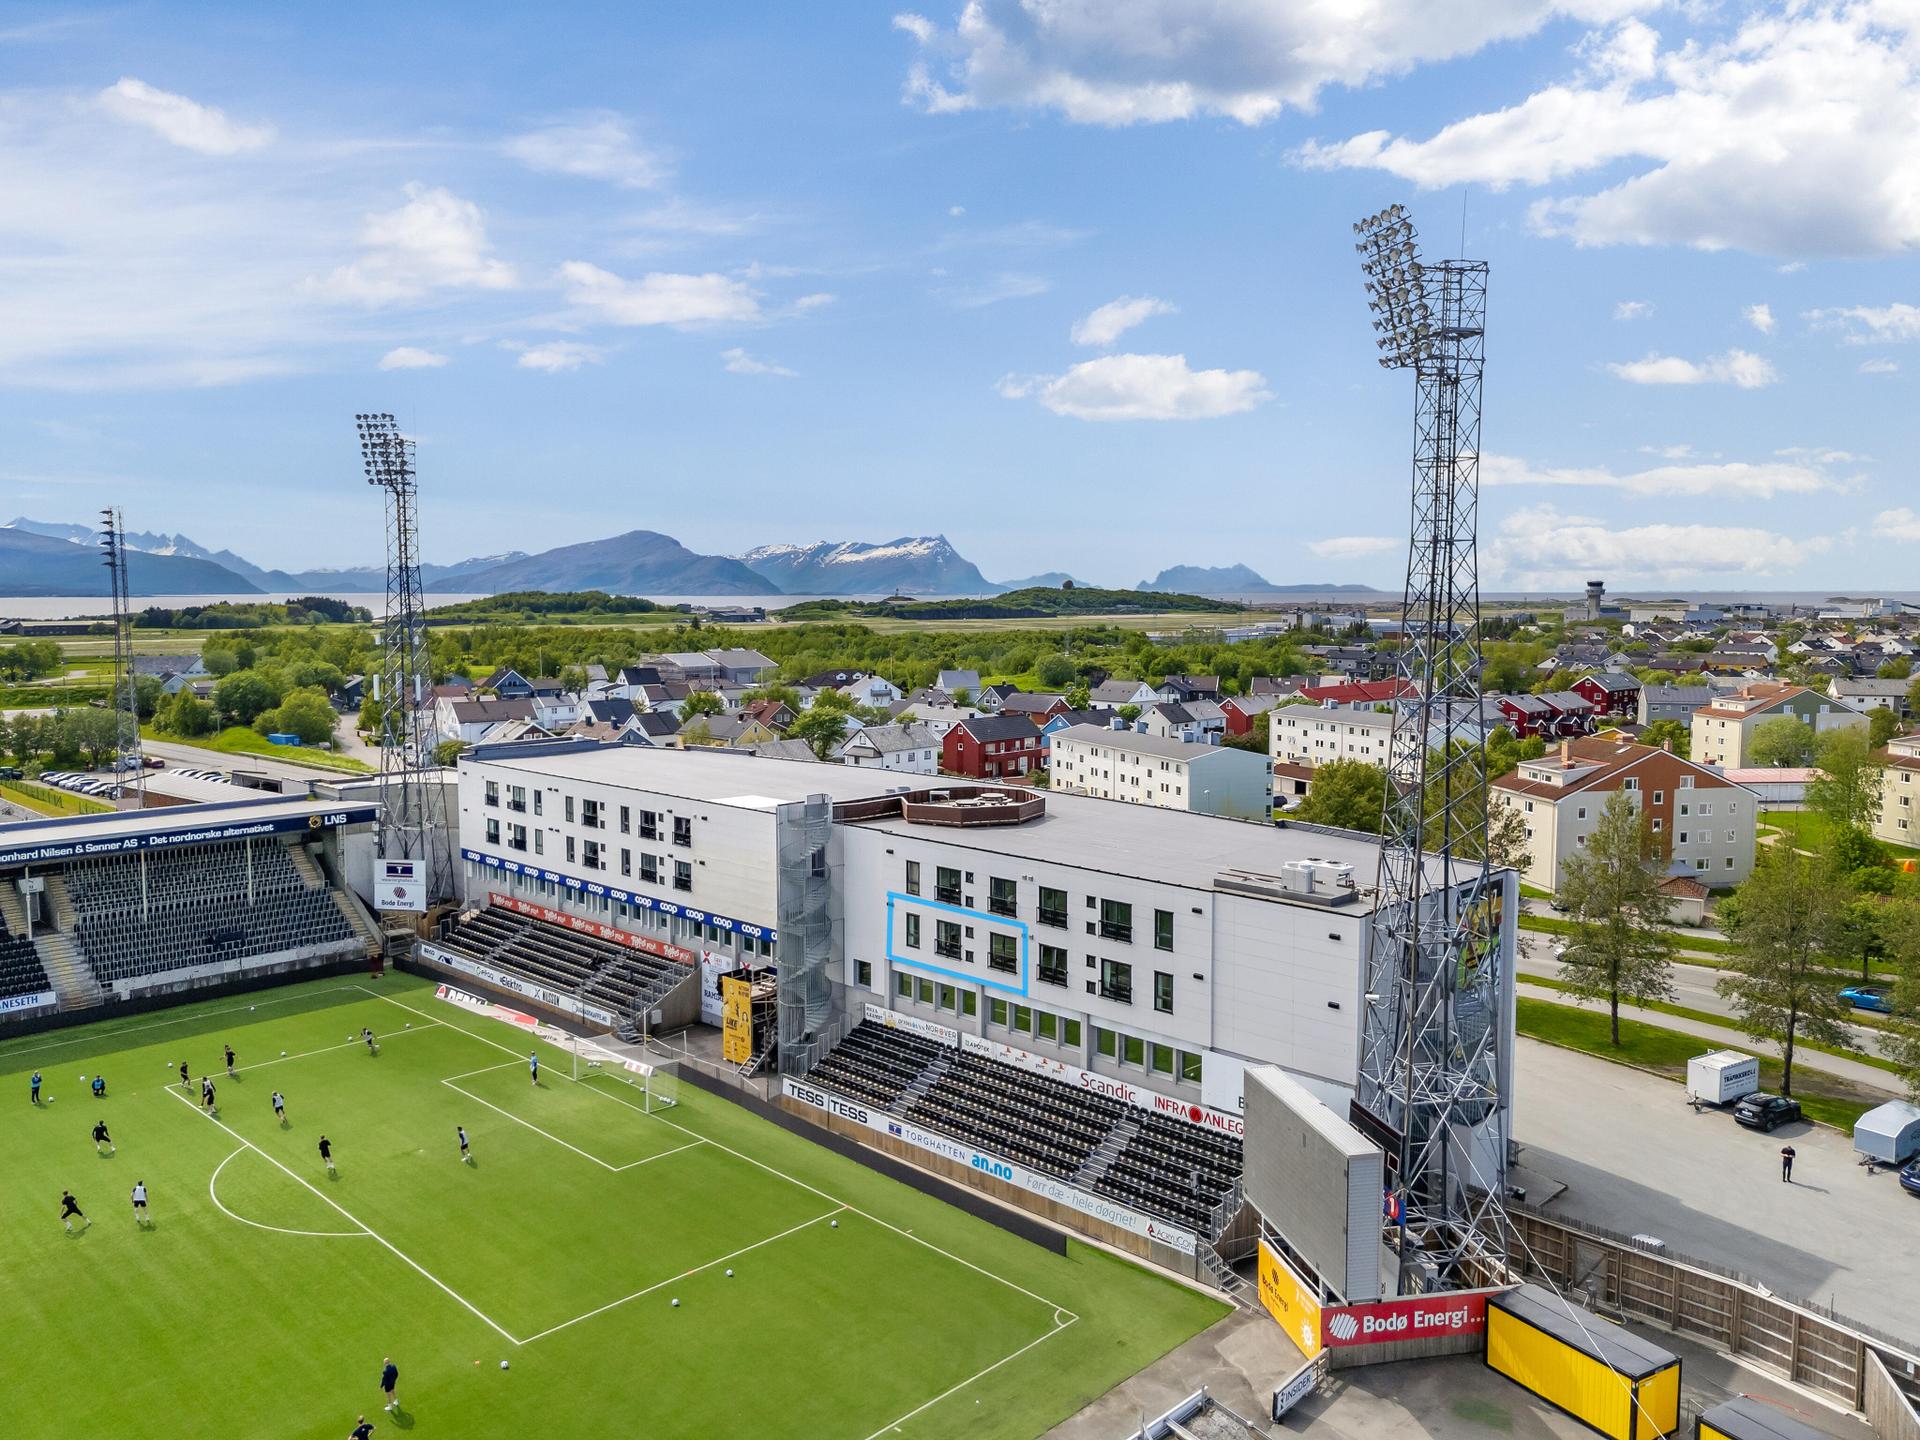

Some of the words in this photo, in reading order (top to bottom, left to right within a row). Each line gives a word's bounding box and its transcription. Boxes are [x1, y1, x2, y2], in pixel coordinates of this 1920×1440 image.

[324, 814, 347, 825] LNS
[0, 850, 38, 862] onhard
[40, 847, 72, 857] Nilsen
[75, 845, 84, 853] &
[86, 841, 121, 852] Sønner
[123, 839, 138, 848] AS
[150, 836, 168, 845] Det
[169, 830, 222, 843] nordnorske
[223, 824, 274, 837] alternativet
[468, 852, 480, 861] coop
[486, 856, 499, 867] coop
[505, 861, 518, 872] coop
[524, 866, 538, 877] coop
[545, 872, 559, 882] coop
[566, 877, 581, 888] coop
[588, 883, 604, 894] coop
[611, 889, 627, 901] coop
[635, 896, 652, 907] coop
[660, 902, 677, 914] coop
[685, 909, 704, 921] coop
[713, 916, 732, 929] coop
[741, 924, 761, 937] coop
[0, 995, 38, 1009] NESETH
[1080, 1072, 1136, 1103] Scandic
[789, 1084, 824, 1107] TESS
[831, 1100, 868, 1123] TESS
[1155, 1096, 1187, 1117] INFRA
[905, 1130, 966, 1160] TORGHATTEN
[972, 1154, 1012, 1180] an.no
[1072, 1193, 1093, 1211] hele
[1096, 1204, 1137, 1228] døgnet!
[1363, 1312, 1408, 1333] Bodø
